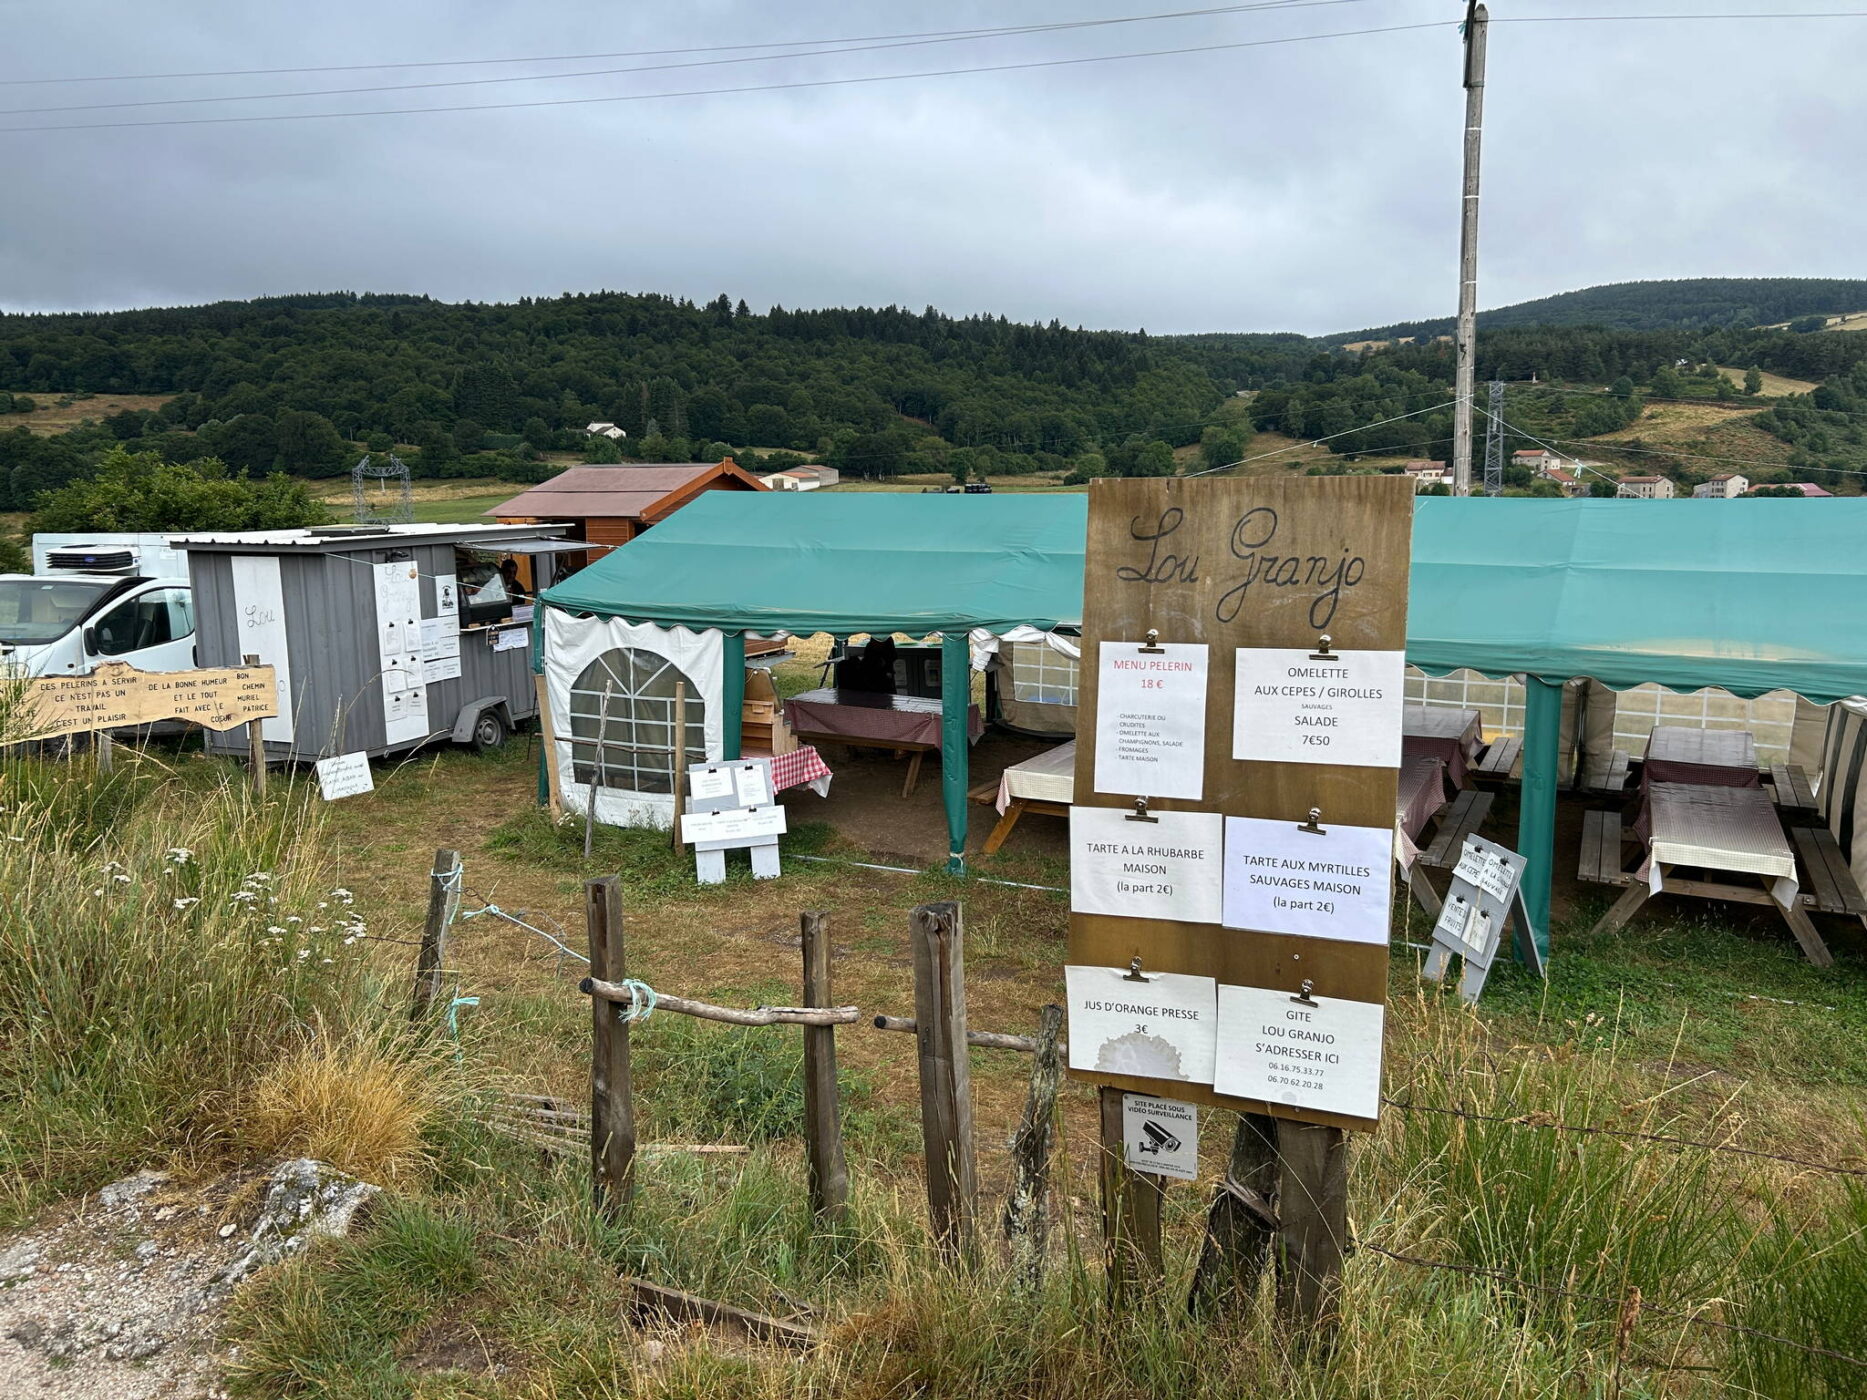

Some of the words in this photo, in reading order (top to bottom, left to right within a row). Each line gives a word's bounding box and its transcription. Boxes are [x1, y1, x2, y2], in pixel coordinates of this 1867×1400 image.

[1116, 507, 1200, 584] Lou
[1216, 507, 1365, 629] Granjo
[1114, 660, 1146, 670] MENU
[1150, 660, 1192, 672] PELERIN
[237, 672, 249, 680] BON
[1288, 667, 1349, 678] OMELETTE
[112, 676, 138, 685] SERVIR
[162, 682, 171, 690] LA
[175, 680, 197, 688] BONNE
[202, 678, 228, 686] HUMEUR
[1141, 679, 1154, 689] 18
[1156, 680, 1164, 689] €
[96, 690, 111, 698] PAS
[174, 694, 182, 702] ET
[187, 692, 196, 700] LE
[200, 690, 218, 700] TOUT
[1254, 685, 1278, 696] AUX
[1281, 686, 1316, 698] CEPES
[1318, 686, 1325, 698] /
[1327, 688, 1382, 699] GIROLLES
[174, 706, 188, 714] FAIT
[194, 704, 210, 712] AVEC
[243, 704, 268, 712] PATRICE
[97, 713, 127, 722] PLAISIR
[1120, 713, 1156, 721] CHARCUTERIE
[1294, 716, 1338, 727] SALADE
[1302, 734, 1330, 746] 7€50
[1086, 843, 1118, 854] TARTE
[1122, 846, 1130, 854] A
[1132, 846, 1144, 856] LA
[1147, 846, 1204, 860] RHUBARBE
[1123, 863, 1167, 875] MAISON
[1243, 855, 1278, 868] TARTE
[1281, 858, 1305, 870] AUX
[1308, 862, 1370, 877] MYRTILLES
[1117, 880, 1130, 892] (la
[1132, 883, 1154, 894] part
[1156, 884, 1173, 896] 2€)
[1250, 874, 1310, 890] SAUVAGES
[1313, 880, 1361, 896] MAISON
[1273, 896, 1286, 908] (la
[1290, 899, 1313, 910] part
[1316, 901, 1334, 915] 2€)
[1084, 1000, 1102, 1010] JUS
[1104, 1002, 1158, 1017] D'ORANGE
[1162, 1008, 1200, 1020] PRESSE
[1286, 1010, 1312, 1022] GITE
[1262, 1025, 1285, 1037] LOU
[1288, 1029, 1335, 1044] GRANJO
[1256, 1042, 1322, 1062] S'ADRESSER
[1324, 1052, 1339, 1064] ICI
[1134, 1100, 1148, 1108] SITE
[1168, 1104, 1185, 1113] SOUS
[1147, 1108, 1192, 1120] SURVEILLANCE
